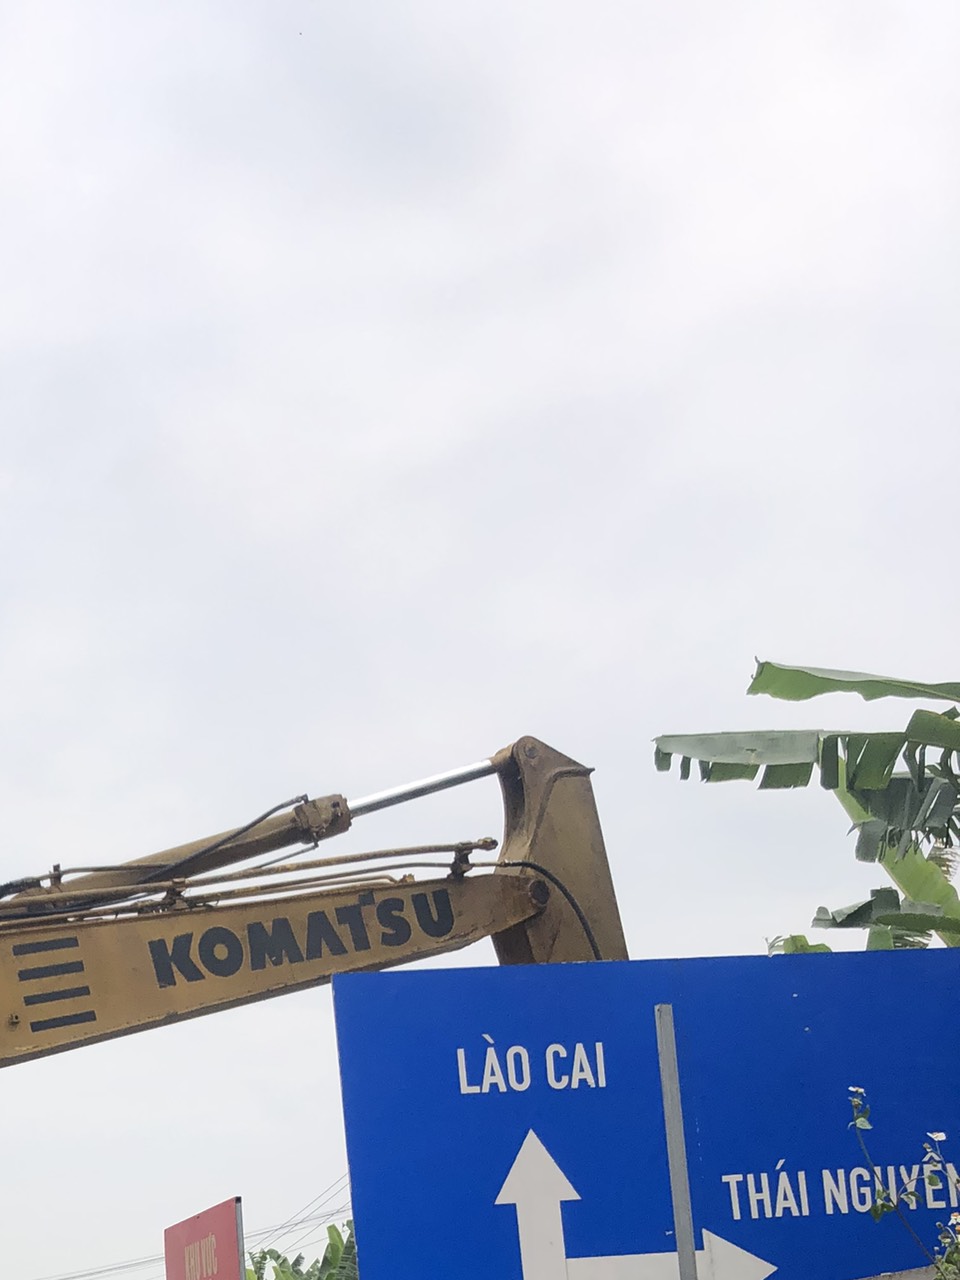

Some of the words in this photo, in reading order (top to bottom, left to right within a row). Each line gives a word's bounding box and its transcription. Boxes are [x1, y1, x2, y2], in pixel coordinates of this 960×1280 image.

[147, 888, 455, 989] KOMATSU
[456, 1033, 531, 1094] LÀO
[545, 1042, 606, 1090] CAI
[722, 1159, 809, 1220] THÁI
